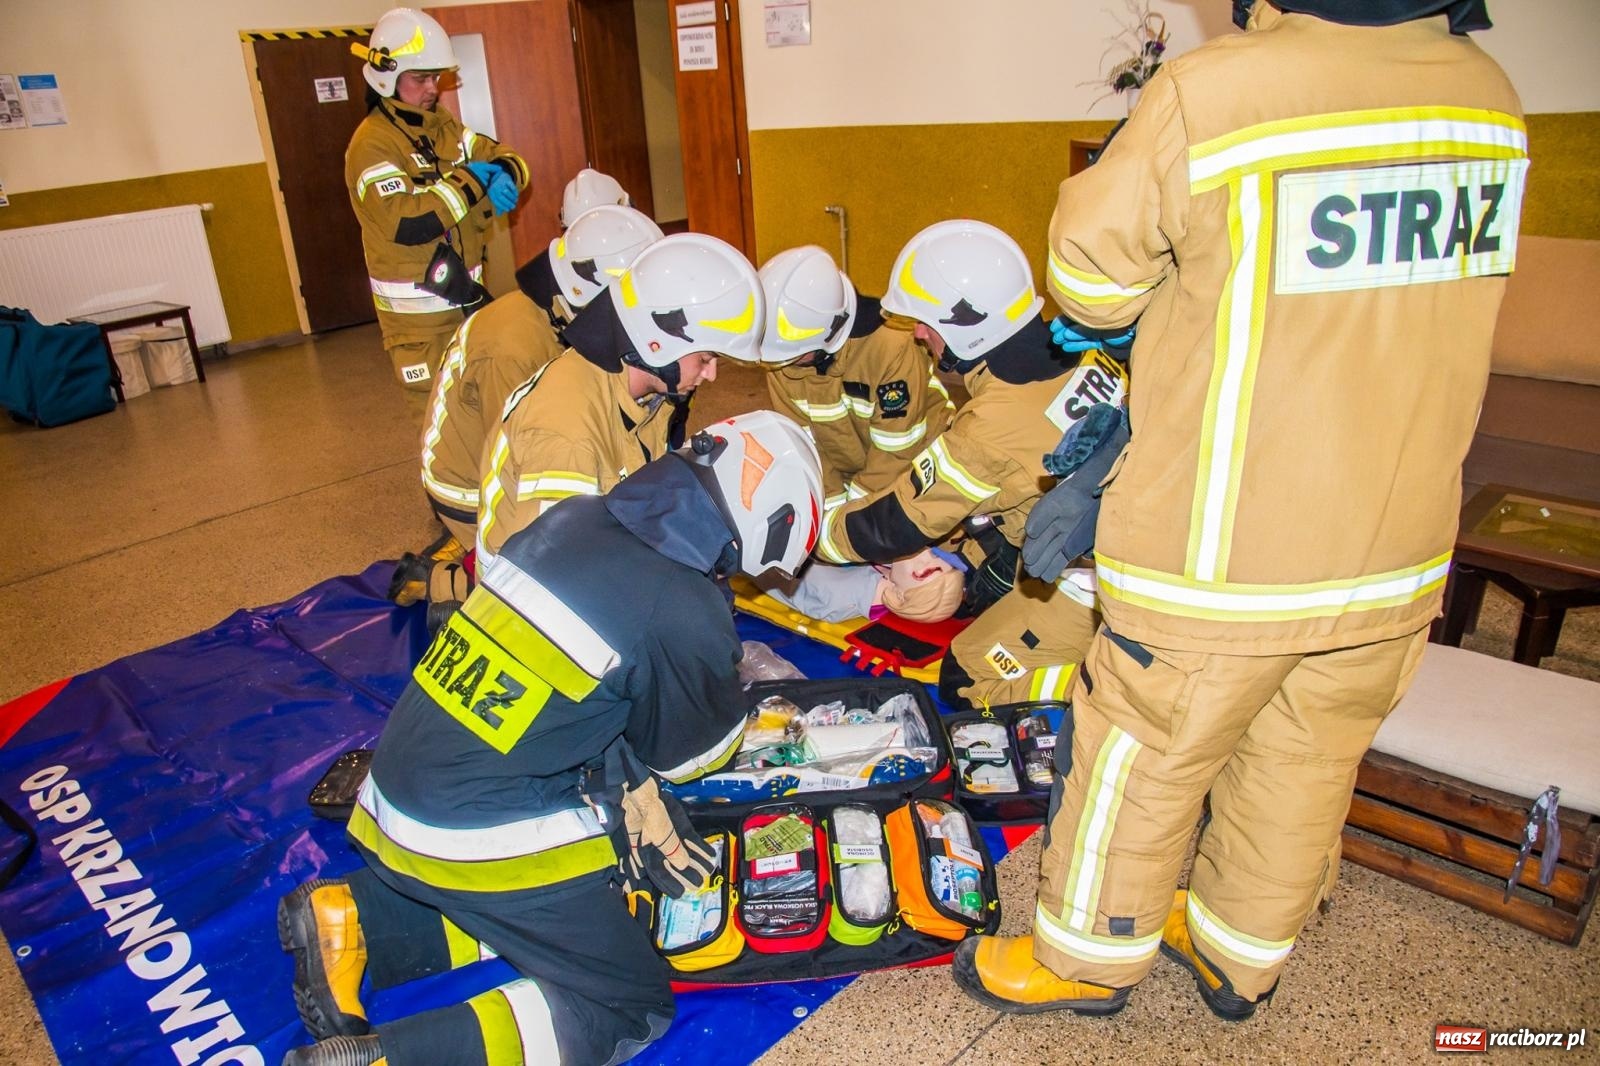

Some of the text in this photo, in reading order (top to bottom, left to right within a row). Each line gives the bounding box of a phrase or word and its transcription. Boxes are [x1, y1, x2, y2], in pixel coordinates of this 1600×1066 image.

[381, 180, 401, 192] OSP
[405, 367, 425, 380] OSP
[993, 651, 1019, 675] OSP
[20, 765, 92, 821] OSP
